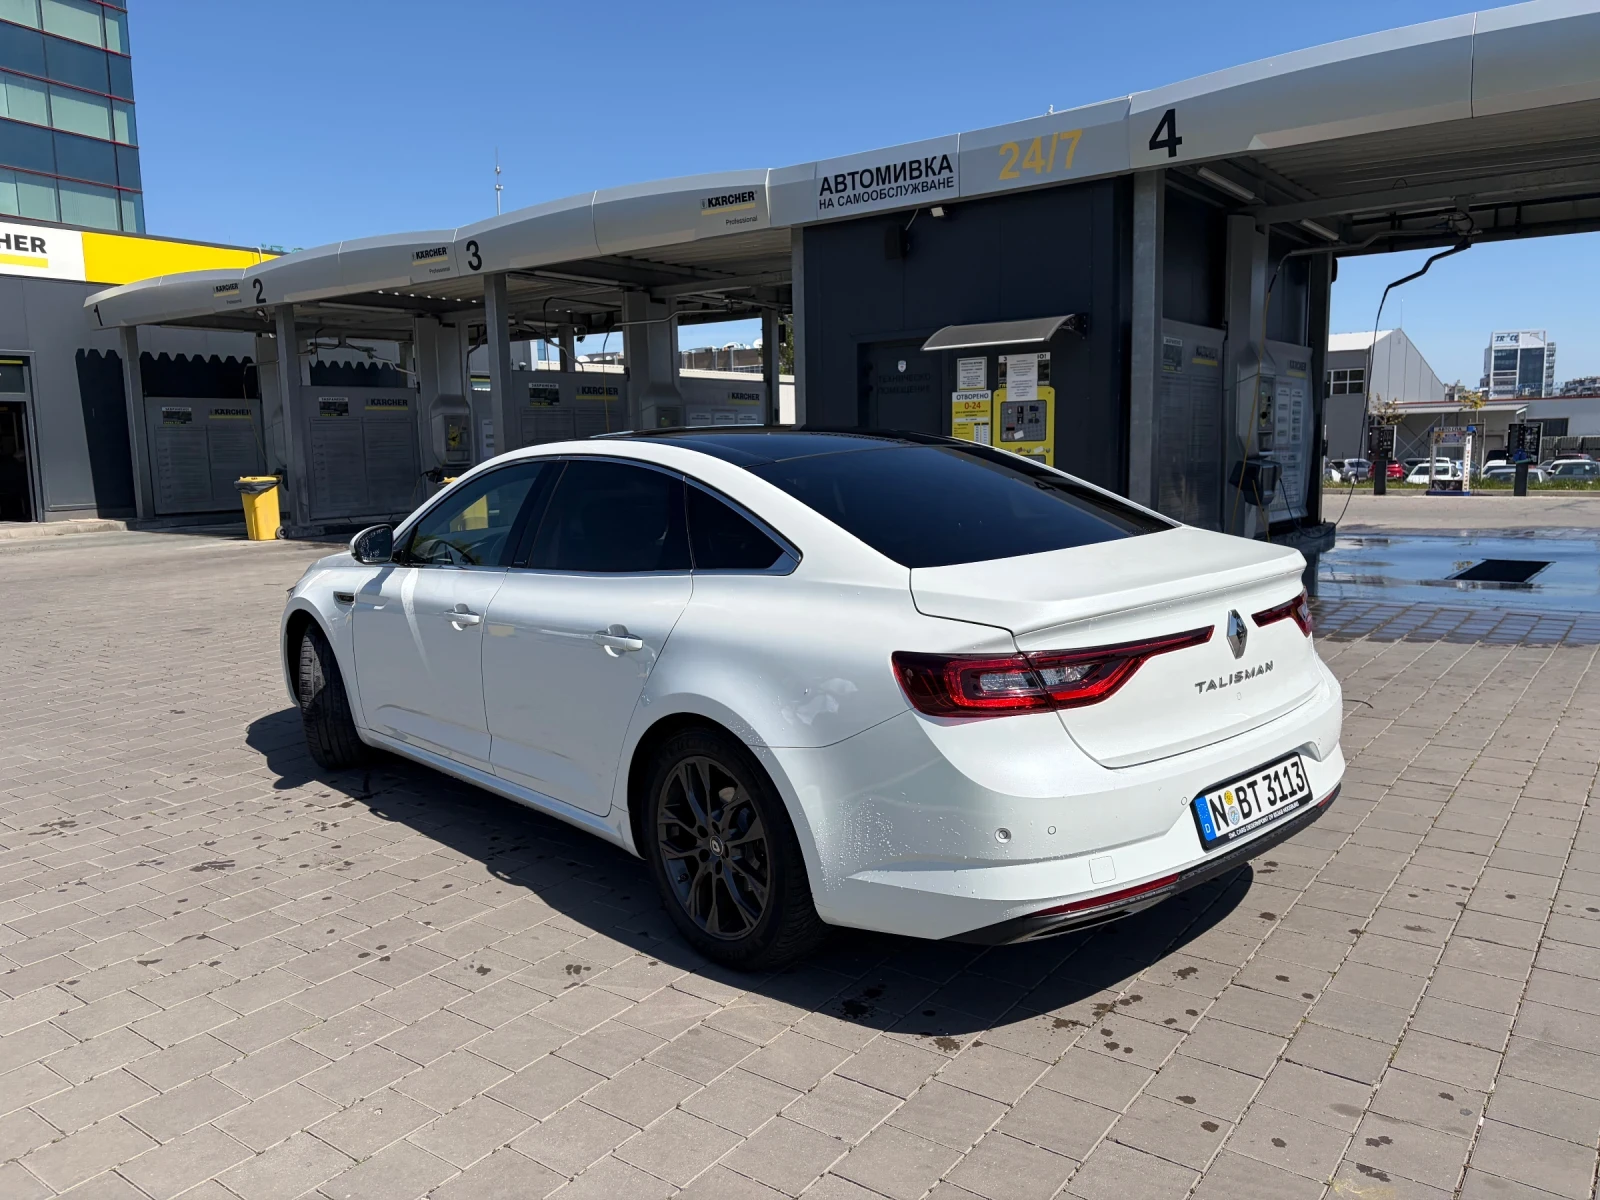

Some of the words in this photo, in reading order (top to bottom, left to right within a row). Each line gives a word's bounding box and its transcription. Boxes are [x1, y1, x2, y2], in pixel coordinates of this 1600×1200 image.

[1148, 108, 1183, 158] 4
[998, 128, 1083, 181] 24/7
[819, 154, 953, 196] АВТОМИВКА
[707, 190, 755, 208] KÄRCHER
[819, 199, 834, 210] НА
[837, 176, 955, 207] САМООБСЛУЖВАНЕ
[725, 215, 758, 226] Professional
[466, 240, 483, 271] 3
[252, 278, 267, 304] 2
[94, 304, 103, 326] 1
[964, 401, 981, 410] 0-24
[1194, 660, 1274, 694] TALISMAN
[1209, 794, 1229, 831] N
[1234, 779, 1262, 820] BT
[1262, 761, 1305, 807] 3113
[1204, 823, 1211, 833] D
